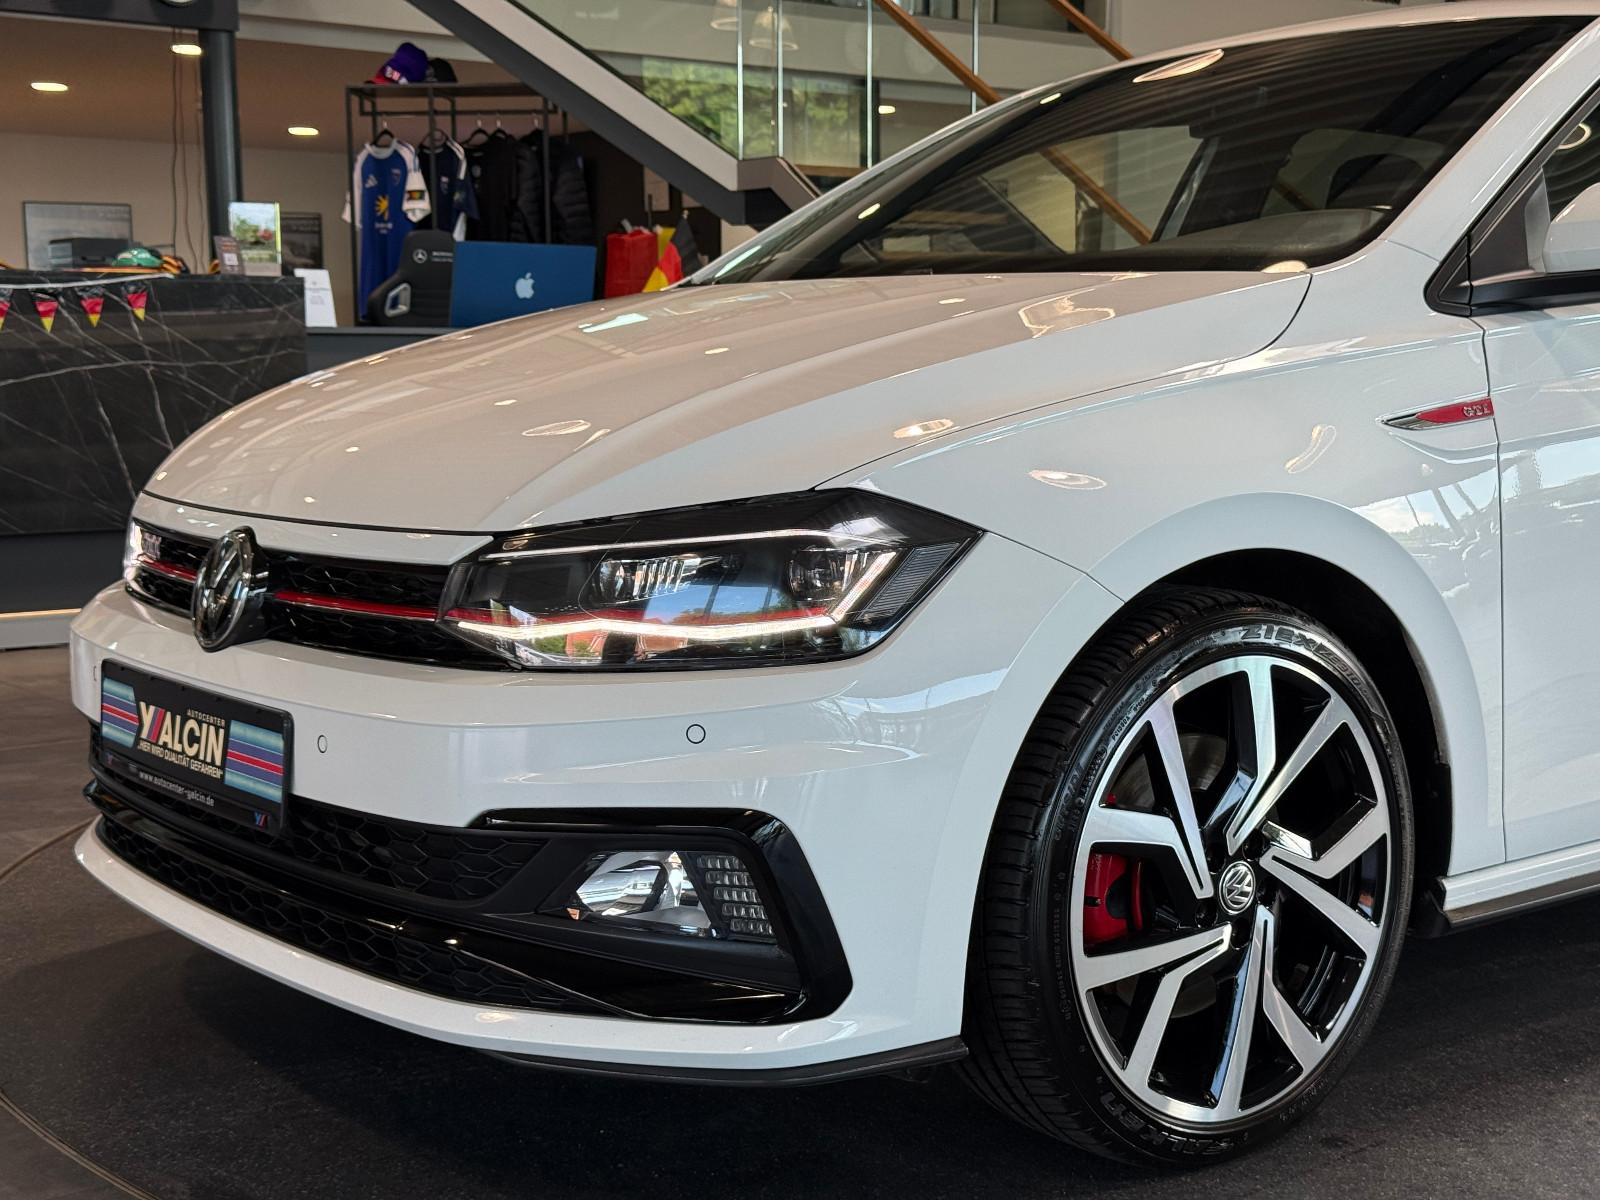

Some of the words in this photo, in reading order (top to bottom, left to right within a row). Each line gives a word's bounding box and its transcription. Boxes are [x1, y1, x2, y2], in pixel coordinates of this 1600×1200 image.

[1241, 623, 1318, 652] ZIEX
[187, 708, 225, 727] AUTOCENTER
[151, 744, 165, 758] WIRD
[164, 749, 190, 767] QUALITÄT
